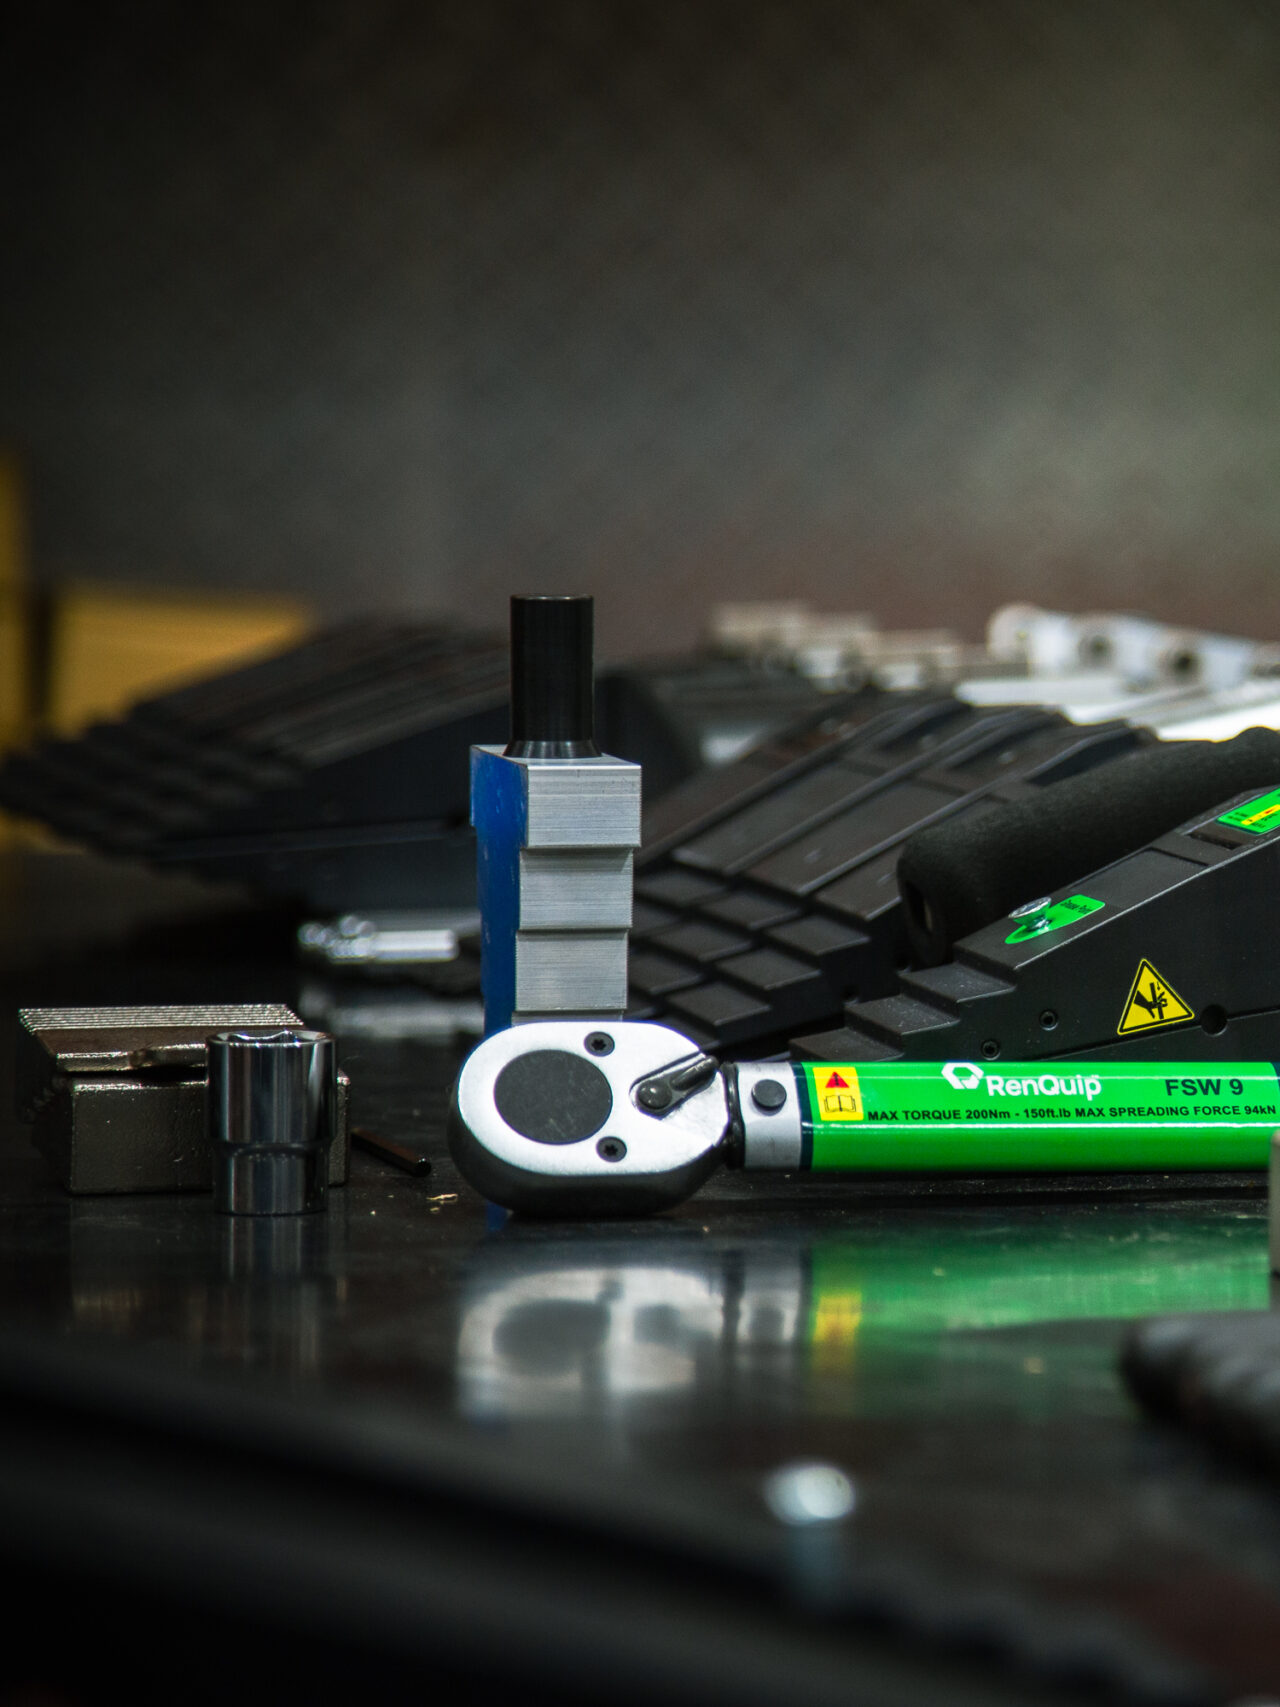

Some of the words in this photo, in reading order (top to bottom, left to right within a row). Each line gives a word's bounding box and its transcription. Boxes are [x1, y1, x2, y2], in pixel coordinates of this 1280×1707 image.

[986, 1075, 1102, 1101] RenQuip
[1165, 1079, 1222, 1096] FSW
[1229, 1079, 1244, 1095] 9
[868, 1110, 898, 1121] MAX
[902, 1109, 961, 1120] TORQUE
[965, 1109, 1011, 1119] 200Nm
[1024, 1108, 1071, 1118] 150ft.lb
[1075, 1107, 1104, 1118] MAX
[1109, 1106, 1190, 1117] SPREADING
[1194, 1105, 1241, 1116] FORCE
[1244, 1105, 1277, 1115] 94kN
